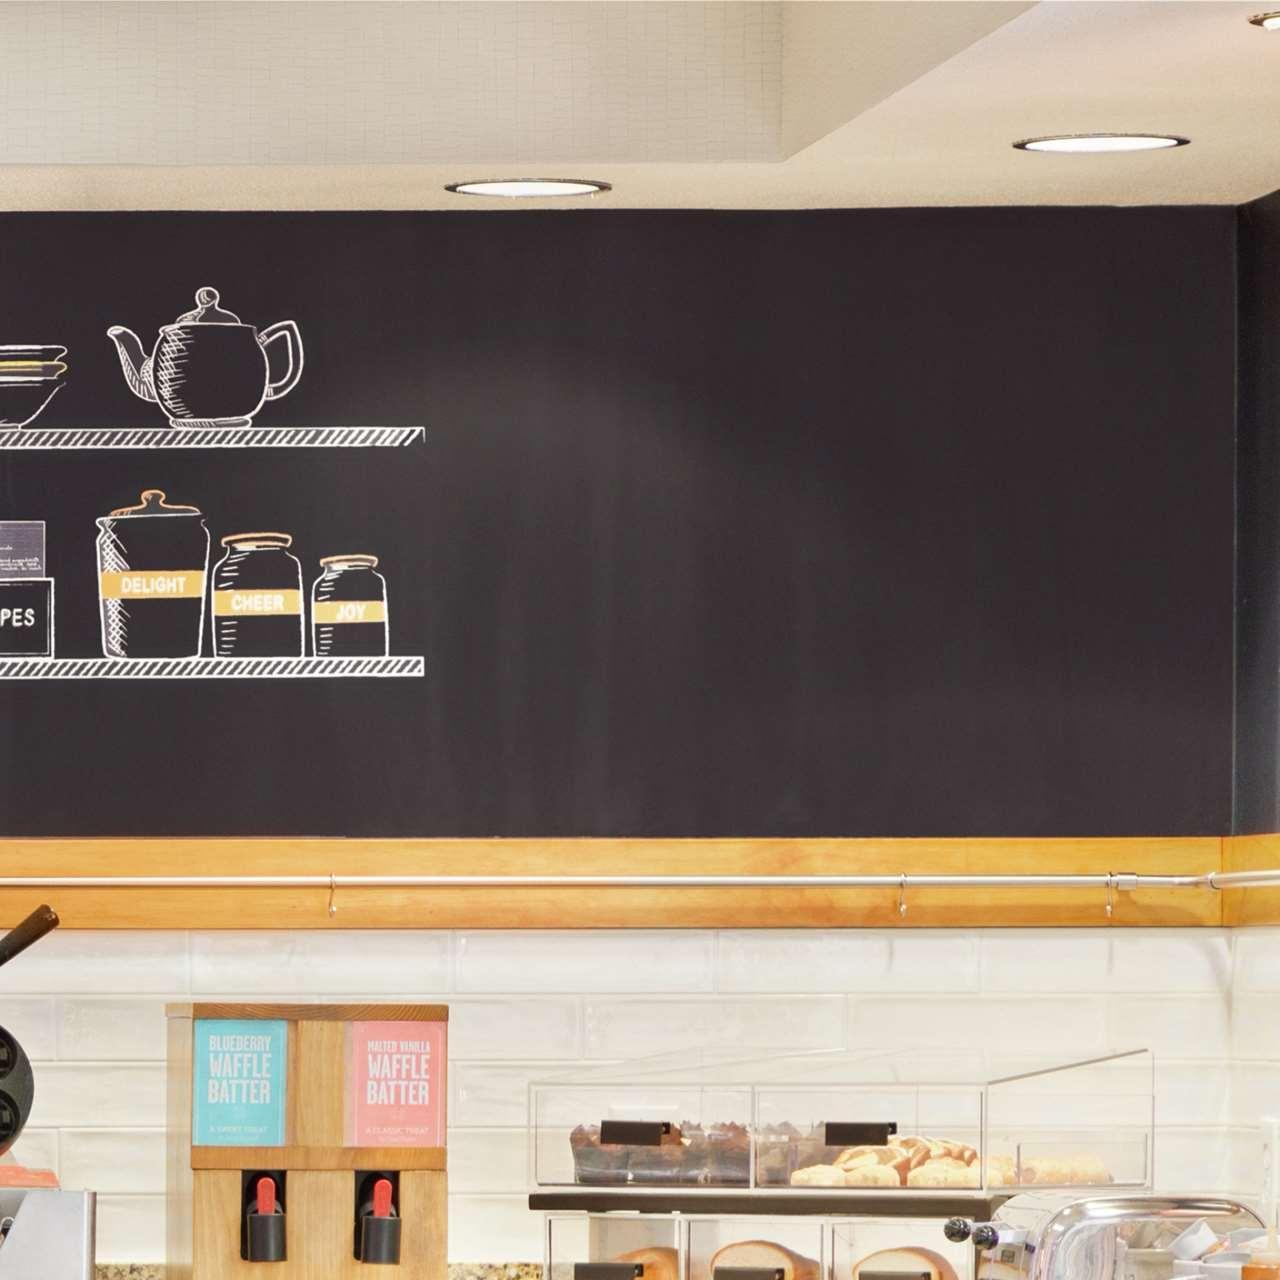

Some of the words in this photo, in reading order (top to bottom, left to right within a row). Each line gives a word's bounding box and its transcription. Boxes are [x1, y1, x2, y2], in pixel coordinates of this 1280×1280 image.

[121, 576, 187, 594] DELIGHT
[231, 594, 284, 611] CHEER
[335, 604, 367, 620] JOY
[208, 1035, 272, 1051] BLUEBERRY
[209, 1053, 272, 1078] WAFFLE
[367, 1054, 430, 1079] WAFFLE
[207, 1079, 272, 1104] BATTER
[366, 1080, 430, 1105] BATTER
